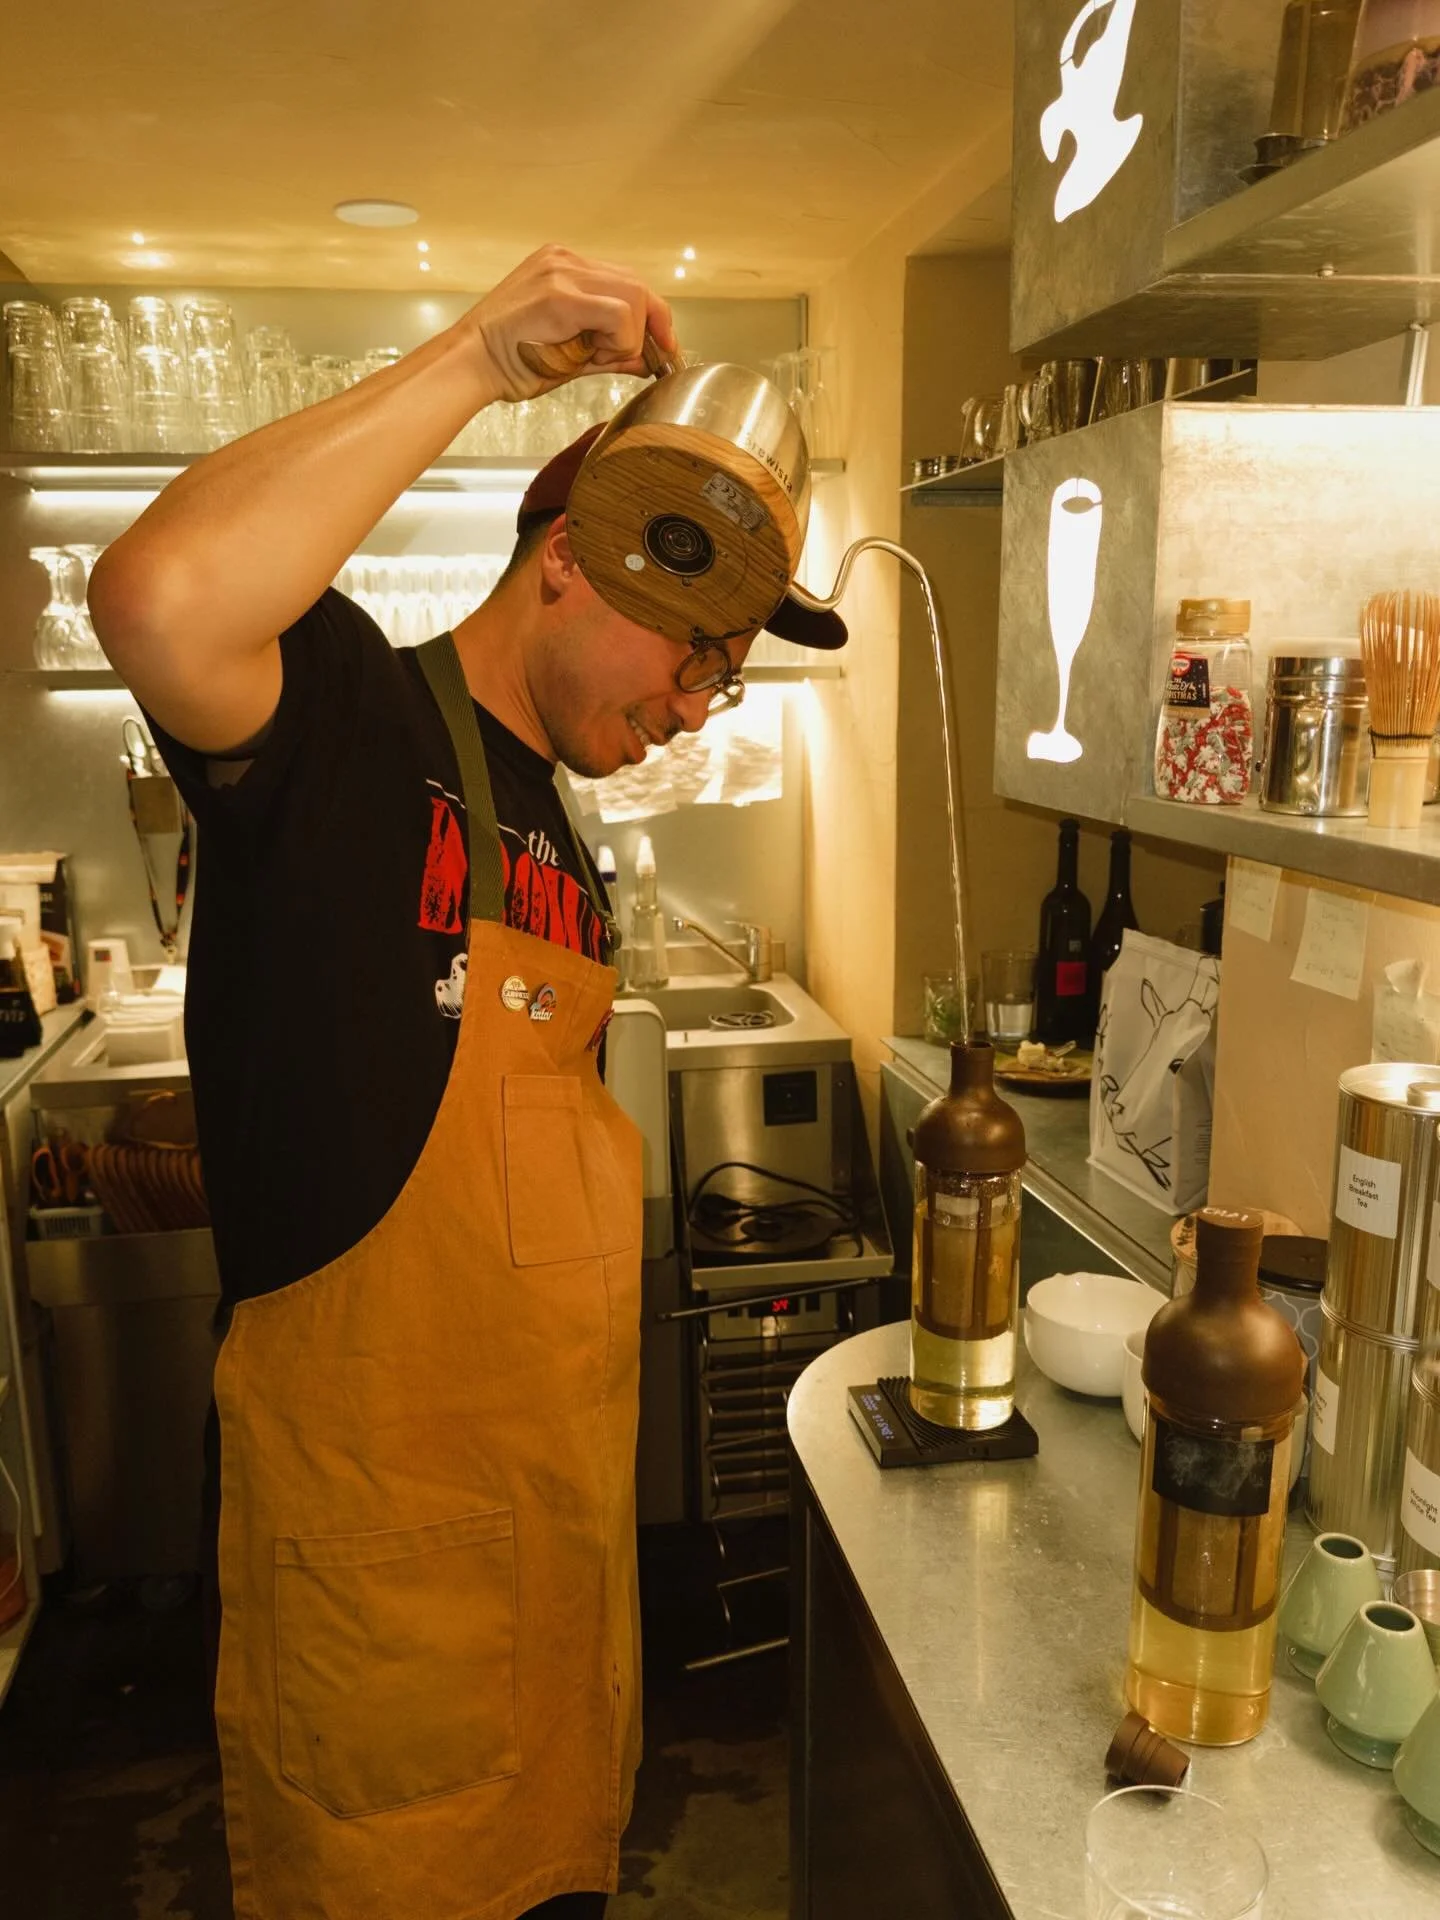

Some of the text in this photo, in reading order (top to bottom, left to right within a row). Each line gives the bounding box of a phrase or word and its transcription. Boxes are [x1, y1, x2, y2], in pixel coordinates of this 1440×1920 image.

[1352, 1173, 1377, 1189] English
[1348, 1183, 1379, 1201] Breakfast
[1356, 1197, 1368, 1209] Tea
[1410, 1487, 1438, 1515] Moonlight
[1425, 1510, 1437, 1524] Tea
